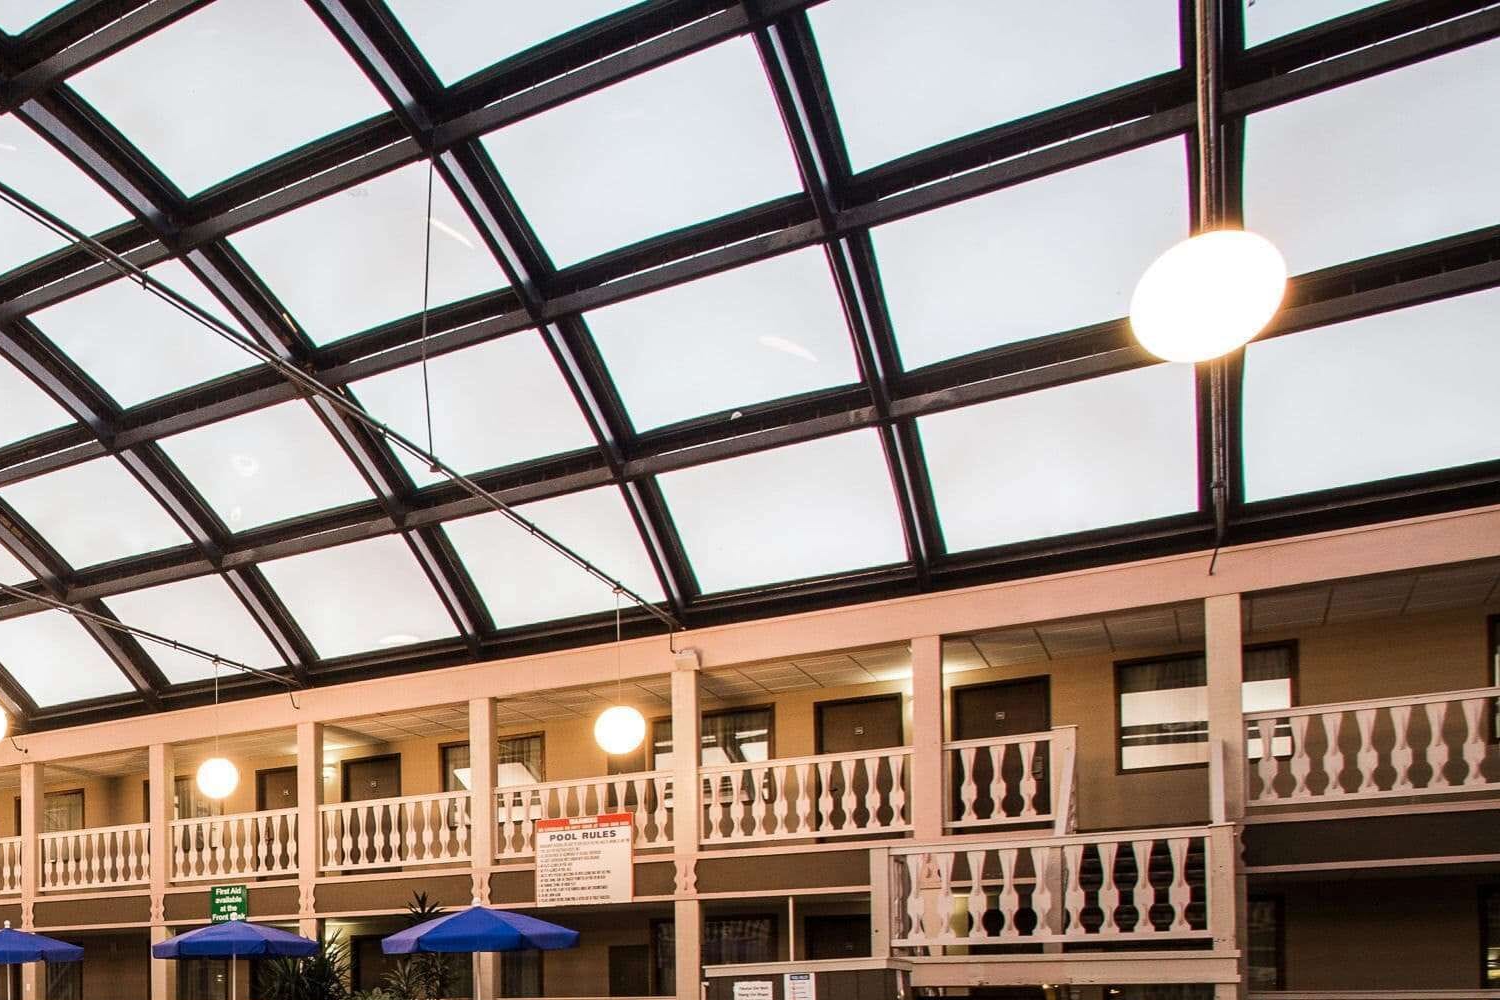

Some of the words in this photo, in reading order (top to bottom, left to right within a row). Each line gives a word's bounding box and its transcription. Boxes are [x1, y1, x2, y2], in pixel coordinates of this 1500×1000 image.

[549, 833, 577, 842] POOL
[582, 830, 617, 839] RULES
[230, 887, 242, 895] Aid
[212, 913, 229, 921] Front
